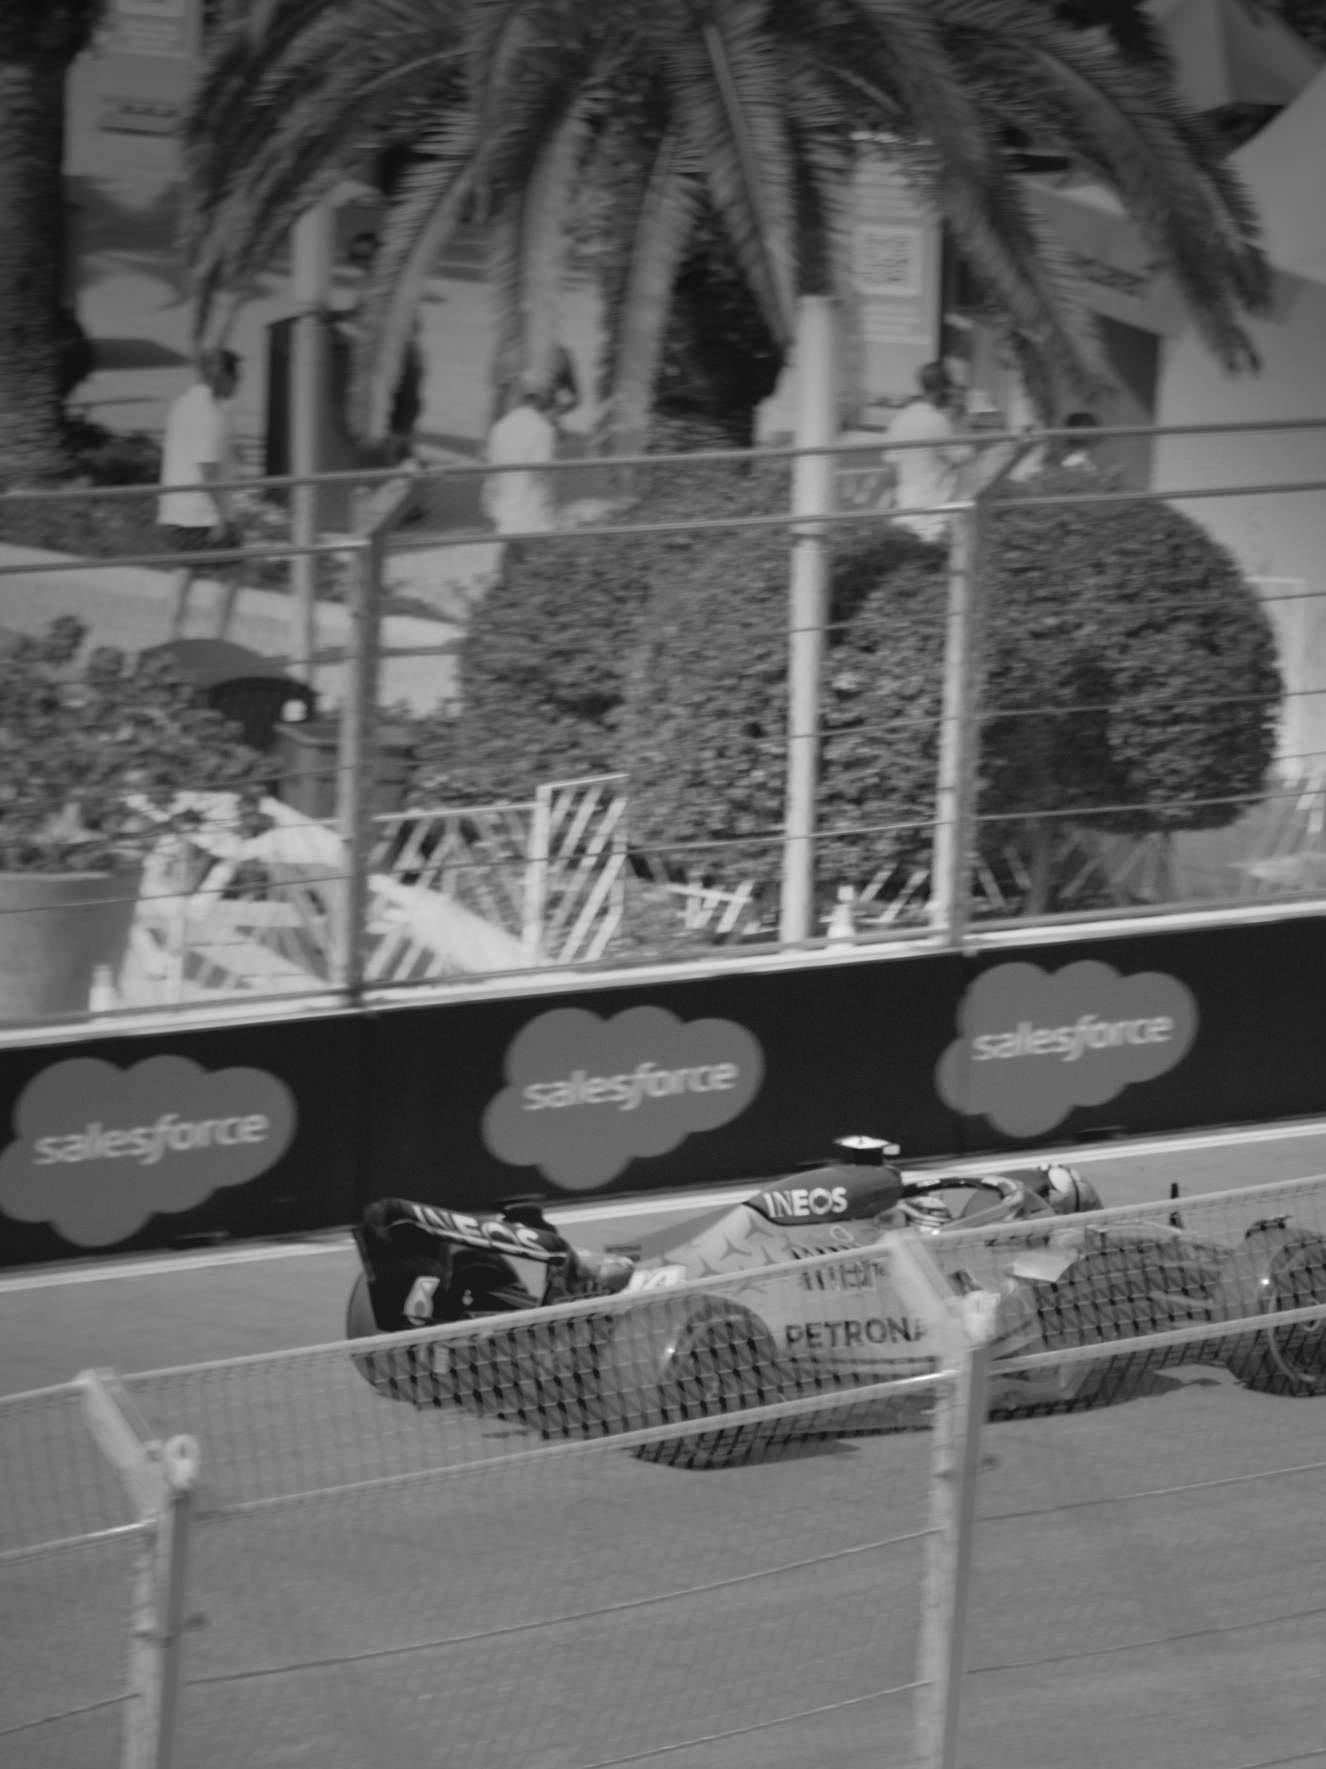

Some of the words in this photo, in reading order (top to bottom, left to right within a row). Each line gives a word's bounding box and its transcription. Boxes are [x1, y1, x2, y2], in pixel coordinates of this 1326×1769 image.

[971, 1014, 1173, 1062] salesforce
[522, 1061, 739, 1111] salesforce
[34, 1113, 270, 1165] salesforce
[763, 1186, 848, 1218] INEOS
[412, 1205, 548, 1253] INEOS
